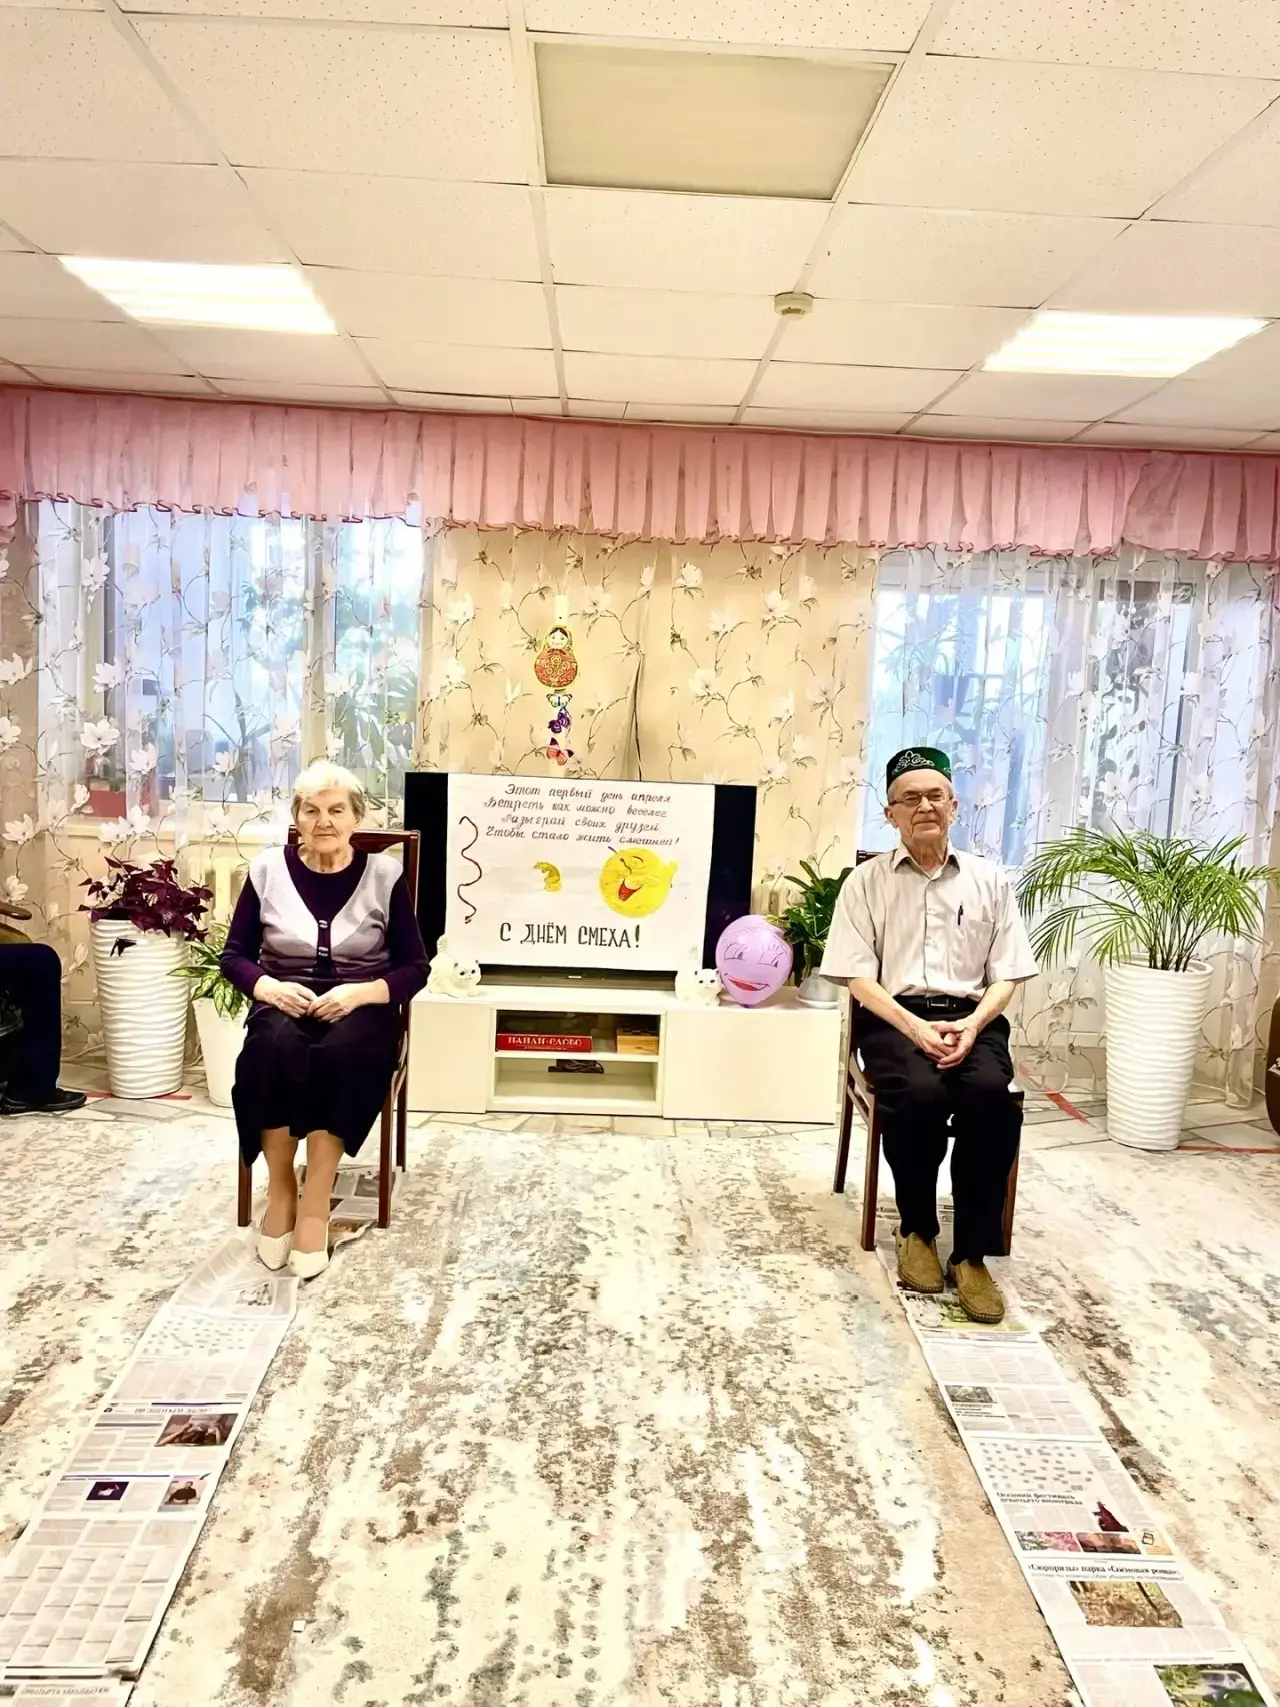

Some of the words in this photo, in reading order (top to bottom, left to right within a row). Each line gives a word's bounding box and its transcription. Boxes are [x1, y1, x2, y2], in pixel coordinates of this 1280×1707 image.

[504, 783, 541, 796] Этот
[548, 786, 593, 800] первый
[600, 791, 623, 803] день
[631, 792, 671, 804] апреля
[483, 796, 545, 812] Встреть
[552, 802, 571, 812] как
[576, 804, 616, 815] можно
[626, 804, 668, 818] веселее
[485, 825, 526, 839] Чтобы
[531, 830, 570, 841] стало
[575, 833, 612, 843] жить
[574, 816, 607, 828] своих
[614, 820, 660, 834] друзей
[499, 922, 511, 942] С
[519, 922, 567, 945] ДНЁМ
